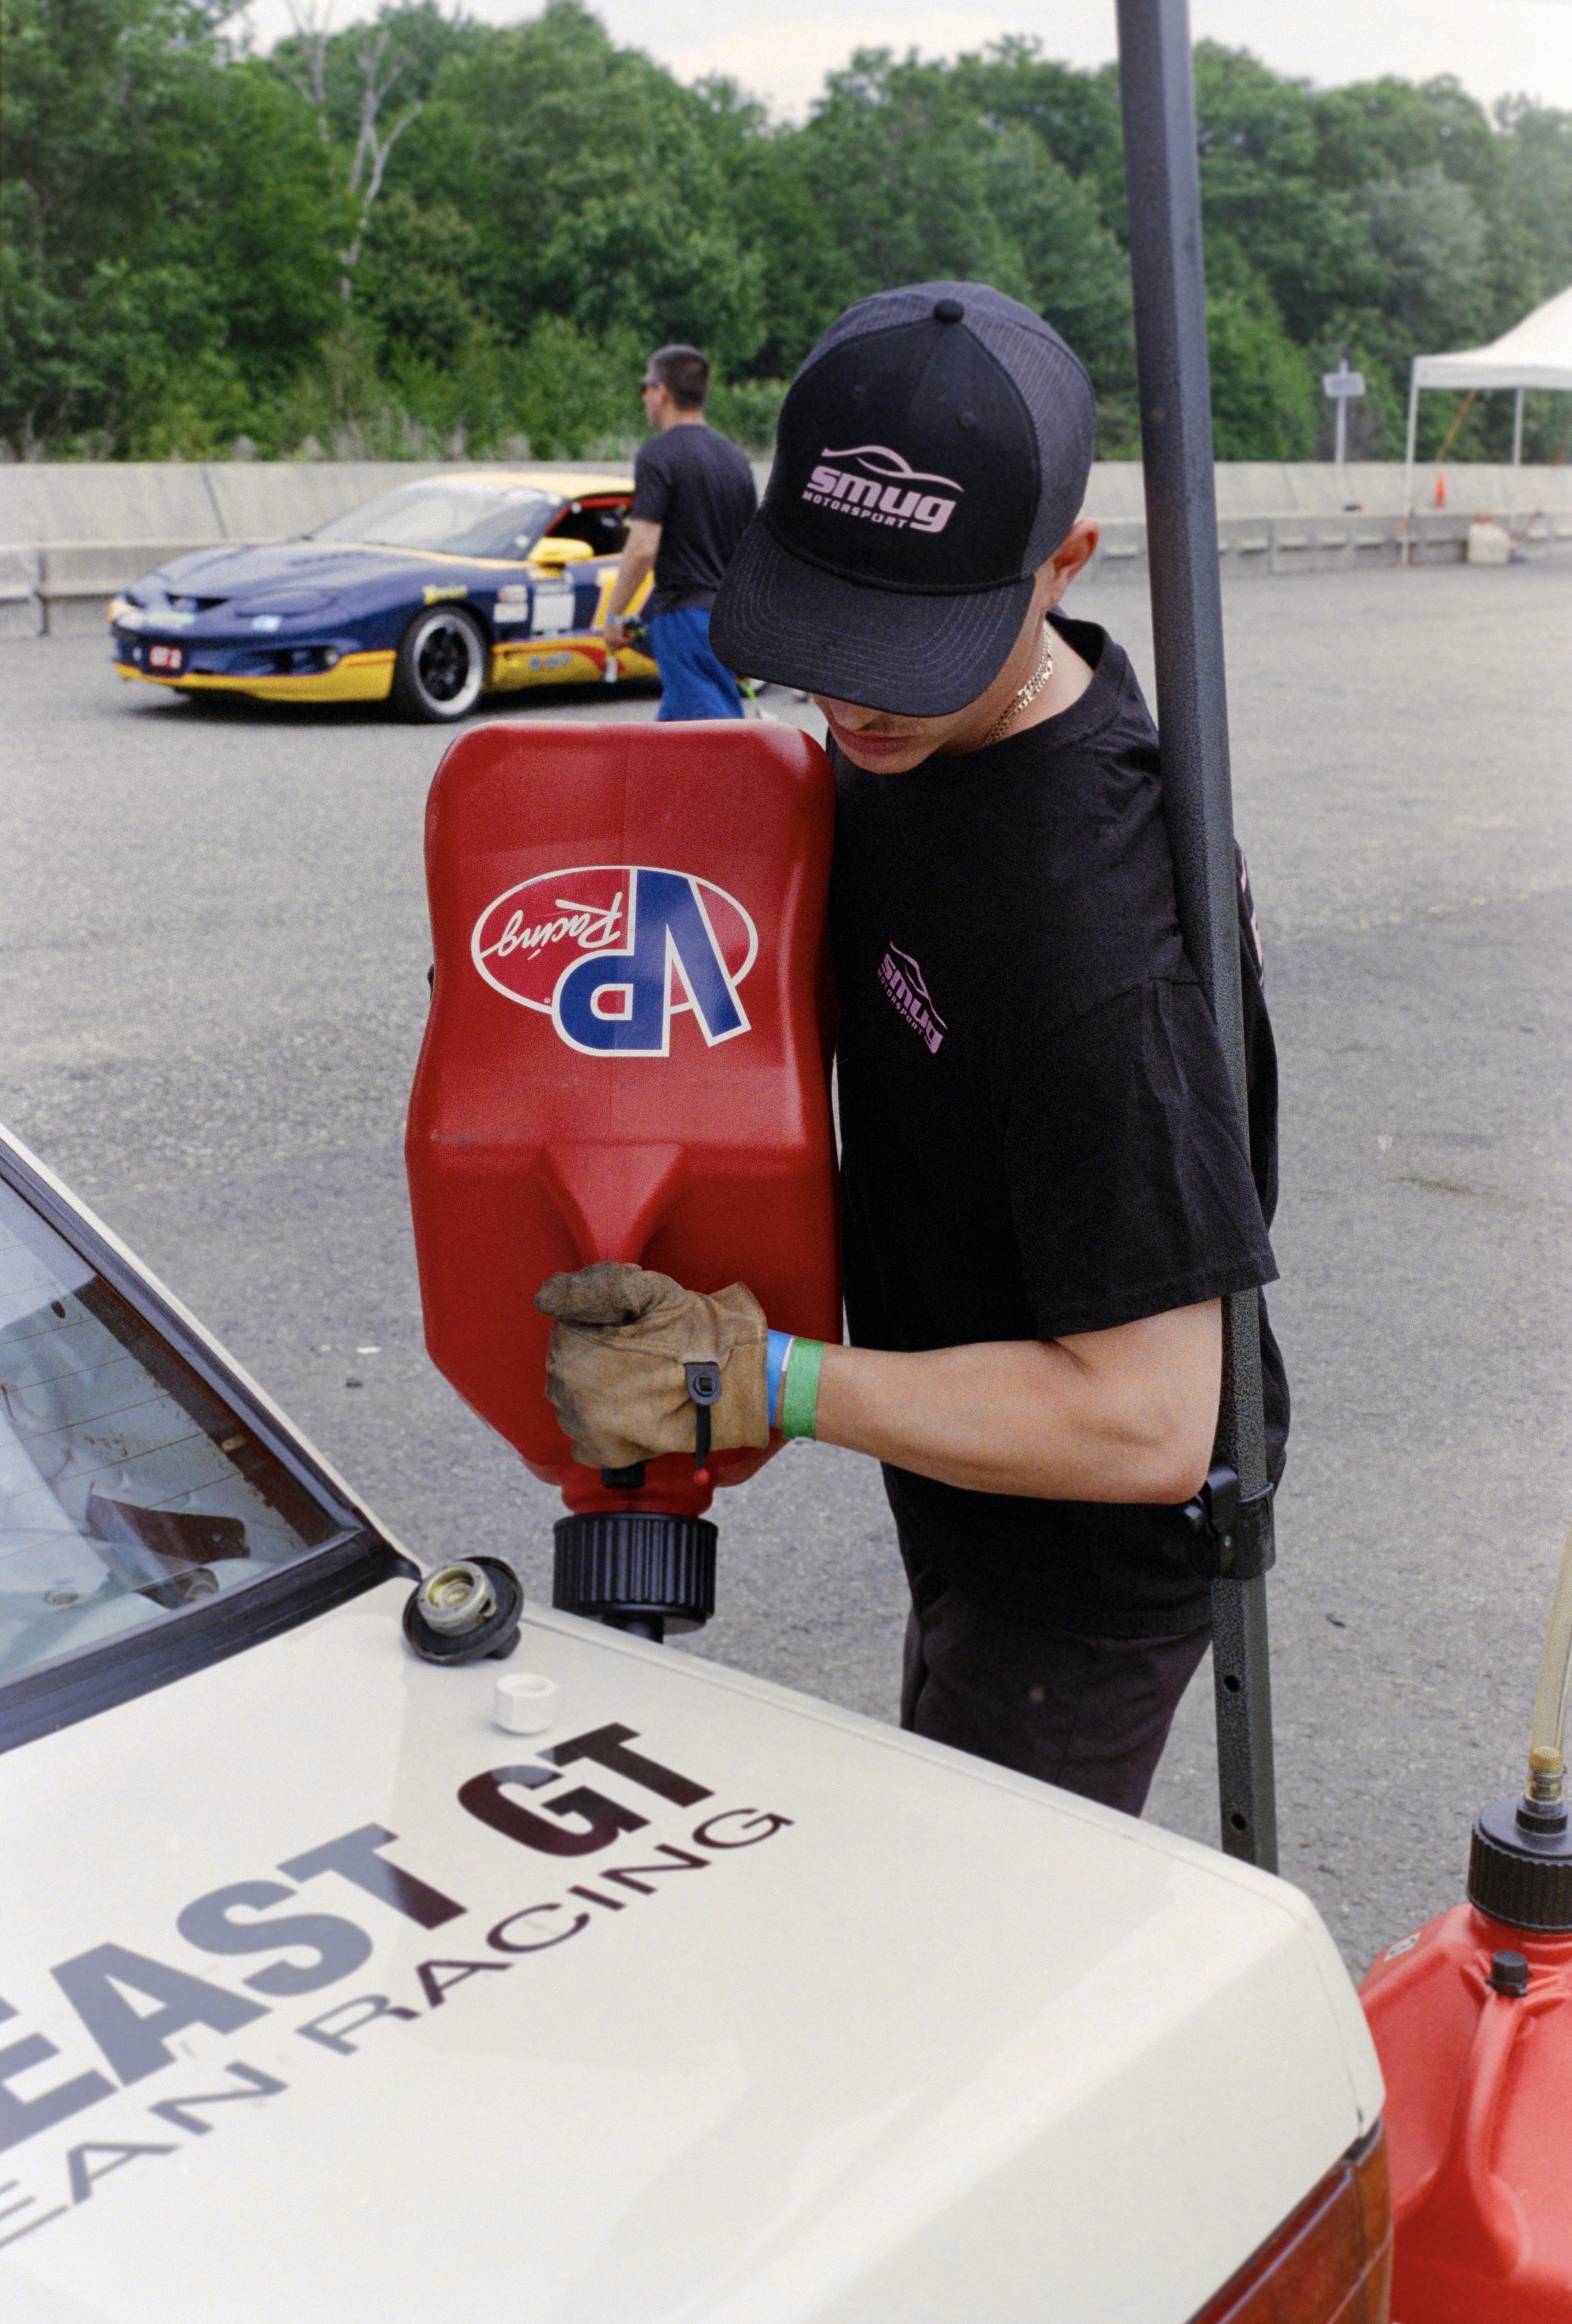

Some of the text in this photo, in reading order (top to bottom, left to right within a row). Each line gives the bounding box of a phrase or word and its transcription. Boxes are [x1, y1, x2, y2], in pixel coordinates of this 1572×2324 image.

[802, 490, 907, 529] MOTORSPORT
[807, 465, 956, 533] smug
[480, 868, 751, 1057] VP Racing
[877, 968, 924, 1035] MOTORSPORT
[458, 1722, 716, 1857] GT
[295, 1808, 795, 2056] RACING
